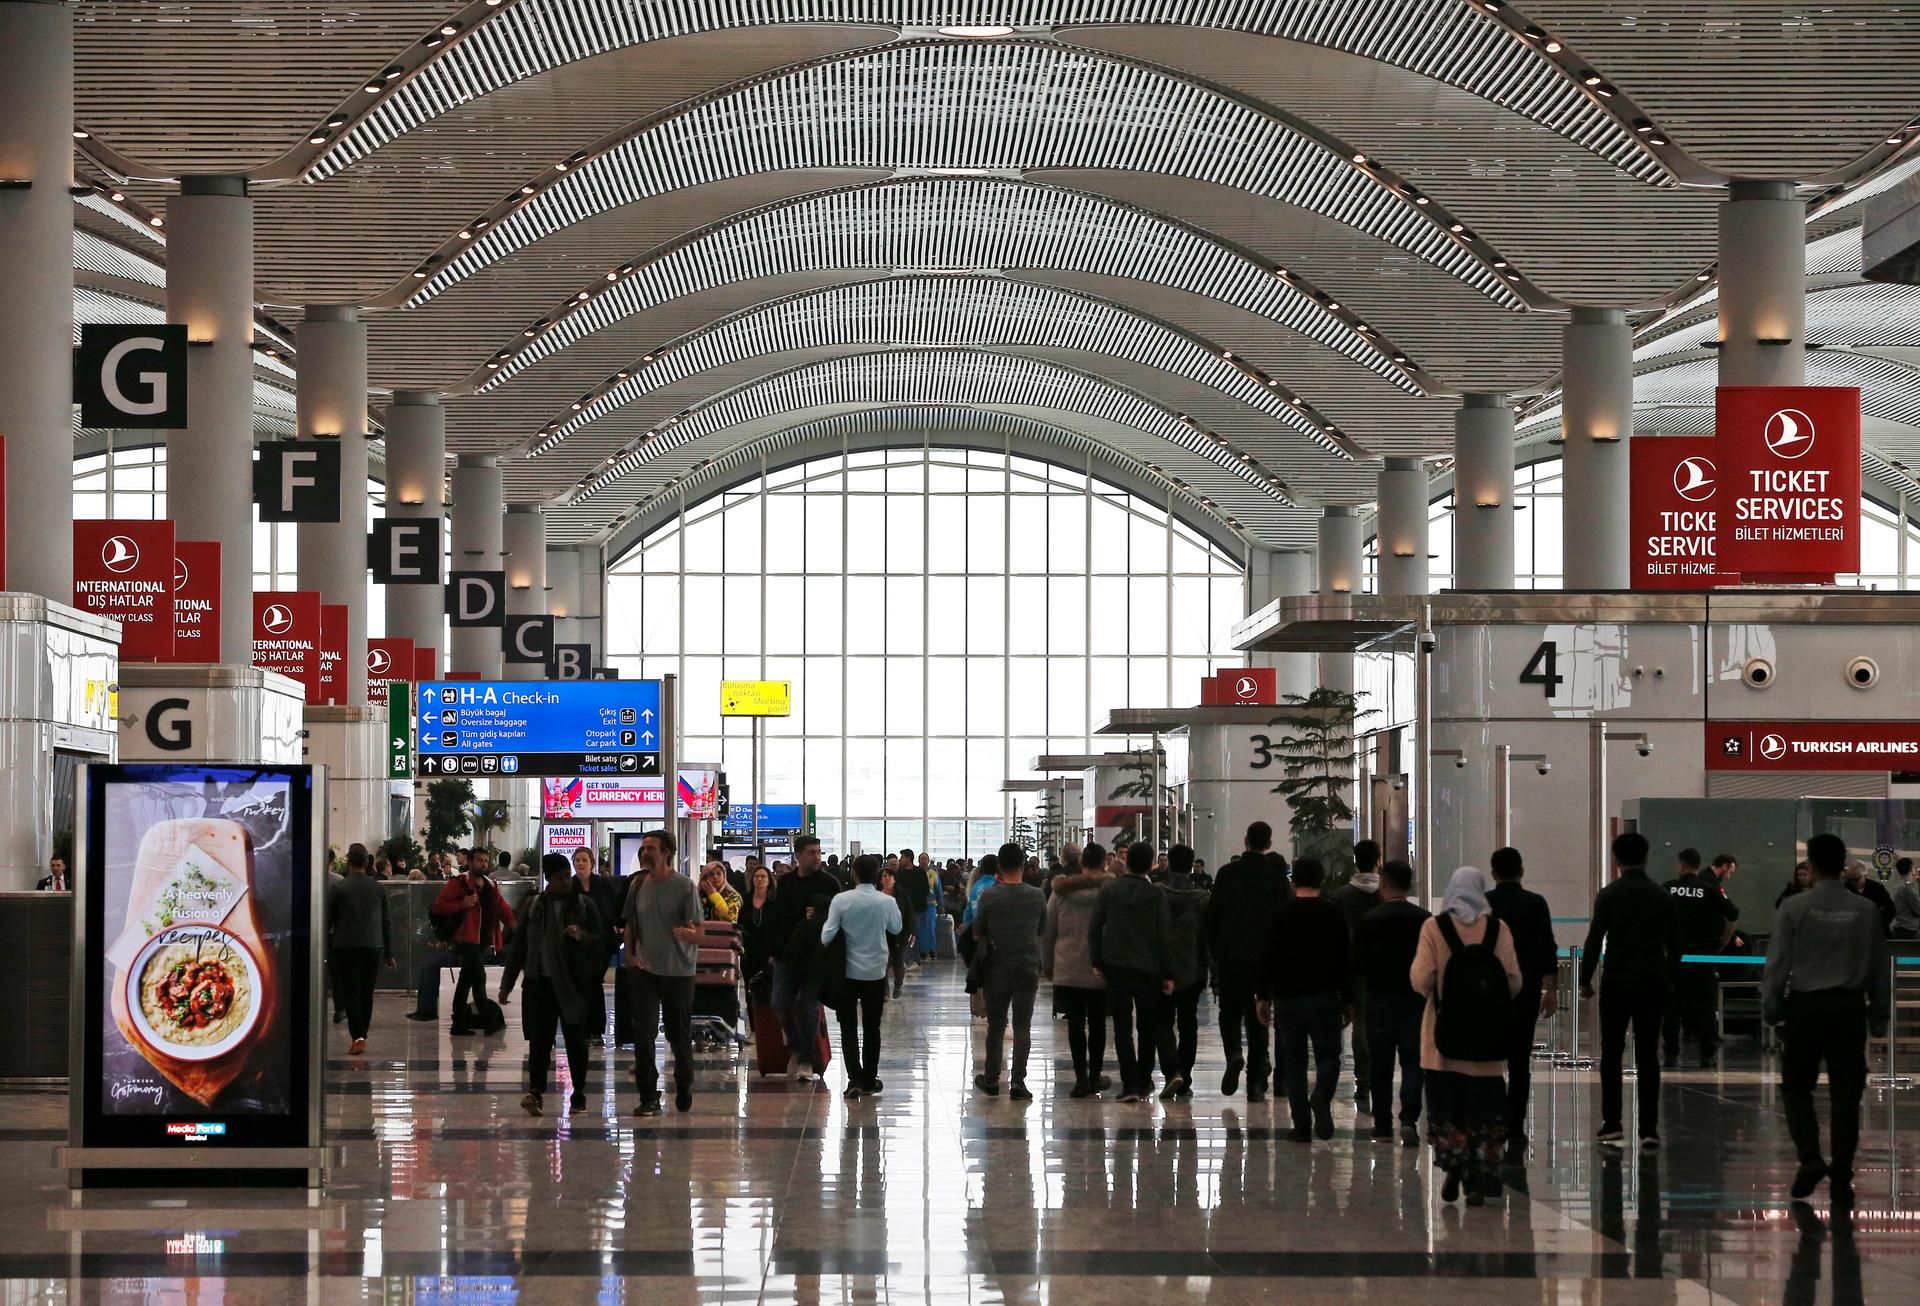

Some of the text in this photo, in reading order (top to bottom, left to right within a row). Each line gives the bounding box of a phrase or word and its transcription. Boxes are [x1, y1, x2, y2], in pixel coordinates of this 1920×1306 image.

[101, 337, 167, 415] G
[281, 452, 317, 512] F
[1750, 470, 1829, 492] TICKET
[1736, 498, 1843, 520] SERVICES
[1735, 525, 1844, 540] BİLET HİZMETLERİ
[391, 526, 421, 576] E
[1648, 561, 1678, 574] BİLET
[76, 581, 166, 593] INTERNATIONAL
[88, 595, 154, 608] DIŞ HATLAR
[459, 578, 495, 620] D
[128, 613, 154, 622] CLASS
[177, 629, 201, 638] CLASS
[515, 620, 543, 657] C
[252, 651, 304, 662] DIŞ HATLAR
[559, 649, 581, 680] B
[1519, 641, 1563, 698] 4
[461, 687, 560, 705] H-A Check-in
[783, 683, 788, 697] 1
[753, 698, 786, 706] Meeting
[461, 708, 506, 718] Büyük bagaj
[145, 698, 192, 751] G
[494, 718, 527, 727] baggage
[461, 730, 526, 739] Tüm gidiş kapıları
[585, 730, 617, 739] Otopark
[472, 741, 493, 749] gates
[600, 740, 617, 749] park
[1791, 741, 1918, 753] TURKISH AIRLINES
[1250, 735, 1273, 768] 3
[463, 760, 477, 768] ATM
[585, 755, 600, 763] Bilet
[579, 764, 618, 772] Ticket sales
[588, 791, 641, 801] CURRENCY
[549, 828, 585, 836] PARANIZI
[166, 889, 233, 901] A heavenly
[172, 908, 226, 918] fusion of
[159, 930, 240, 961] recipes
